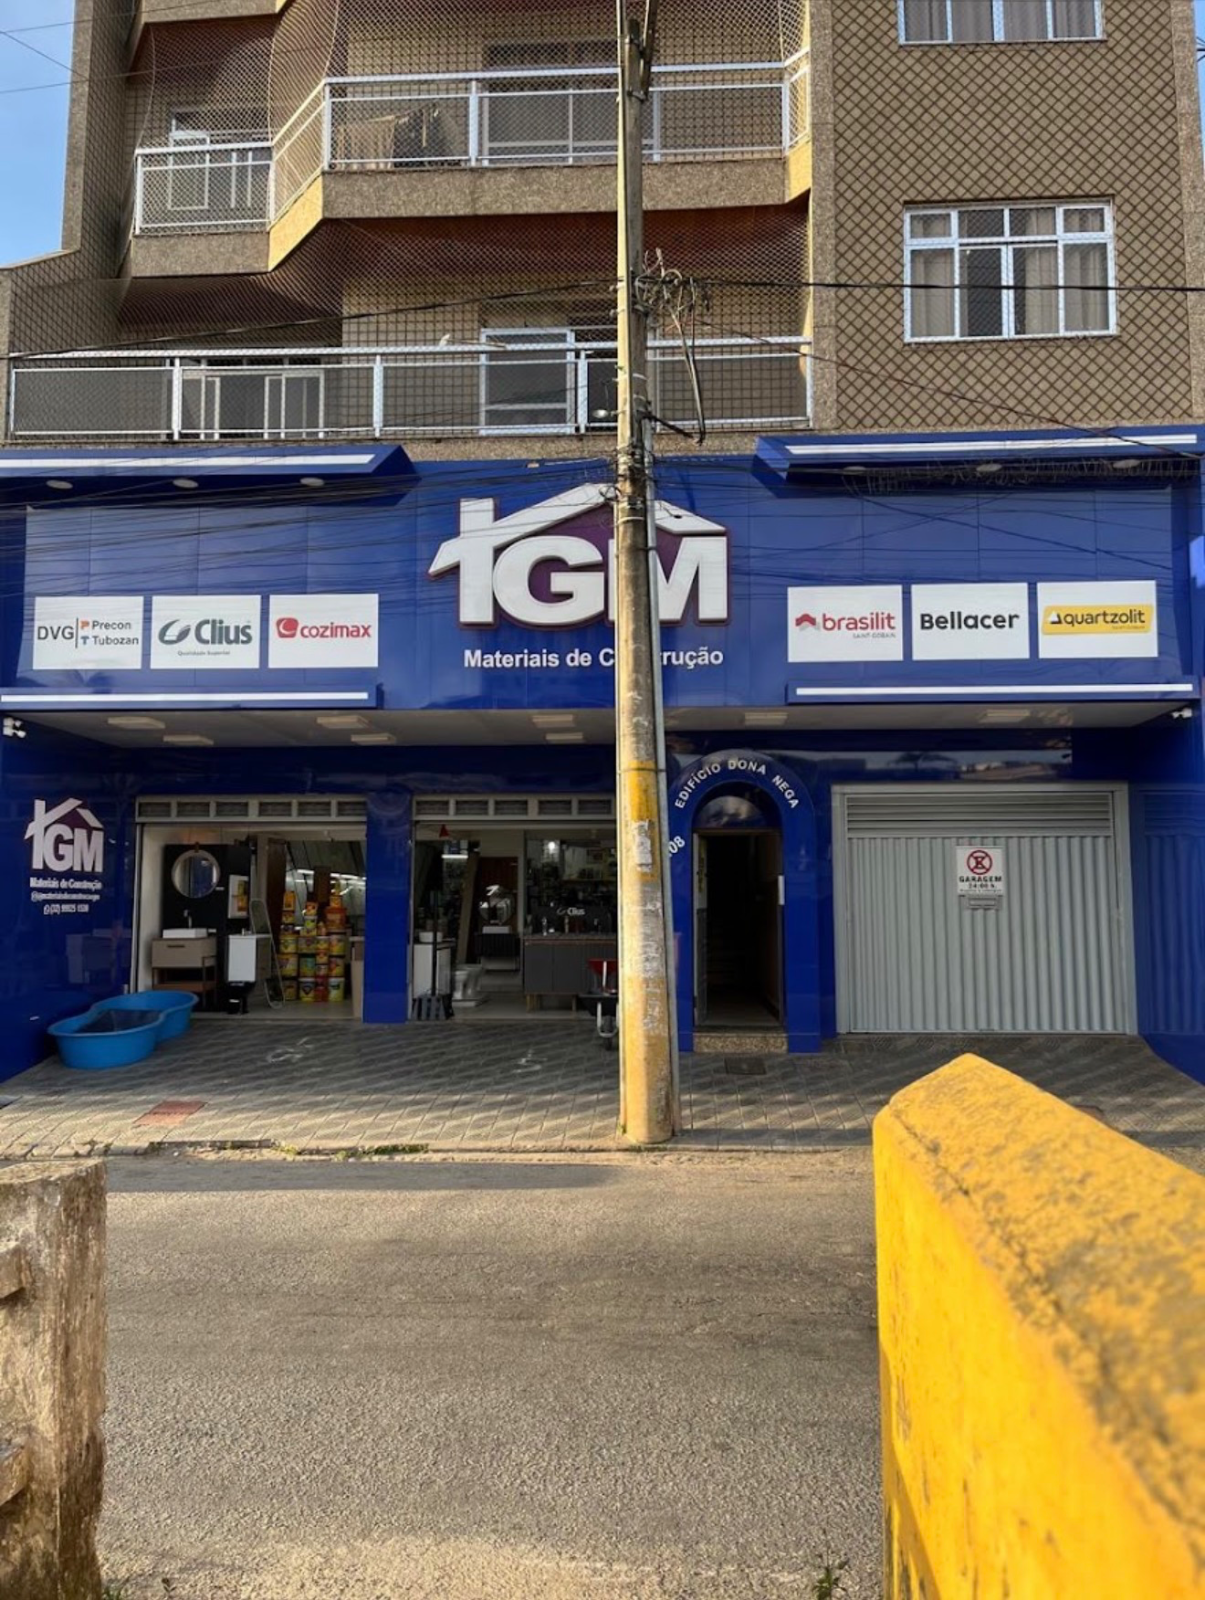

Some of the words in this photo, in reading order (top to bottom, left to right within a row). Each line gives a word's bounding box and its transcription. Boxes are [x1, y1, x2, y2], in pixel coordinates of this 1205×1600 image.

[92, 620, 132, 630] Precon
[822, 612, 896, 631] brasilit
[920, 611, 1020, 630] Bellacer
[1063, 609, 1146, 627] quartzolit
[37, 625, 75, 640] DVG
[194, 618, 253, 646] Clius
[300, 621, 372, 639] cozimax
[92, 635, 139, 646] Tubozan
[463, 649, 560, 668] Materiais
[566, 649, 593, 666] de
[599, 647, 724, 669] Crução
[674, 763, 721, 809] EDIFÍCIO
[727, 760, 767, 775] DONA
[772, 775, 799, 808] NEGA
[668, 835, 686, 857] 08
